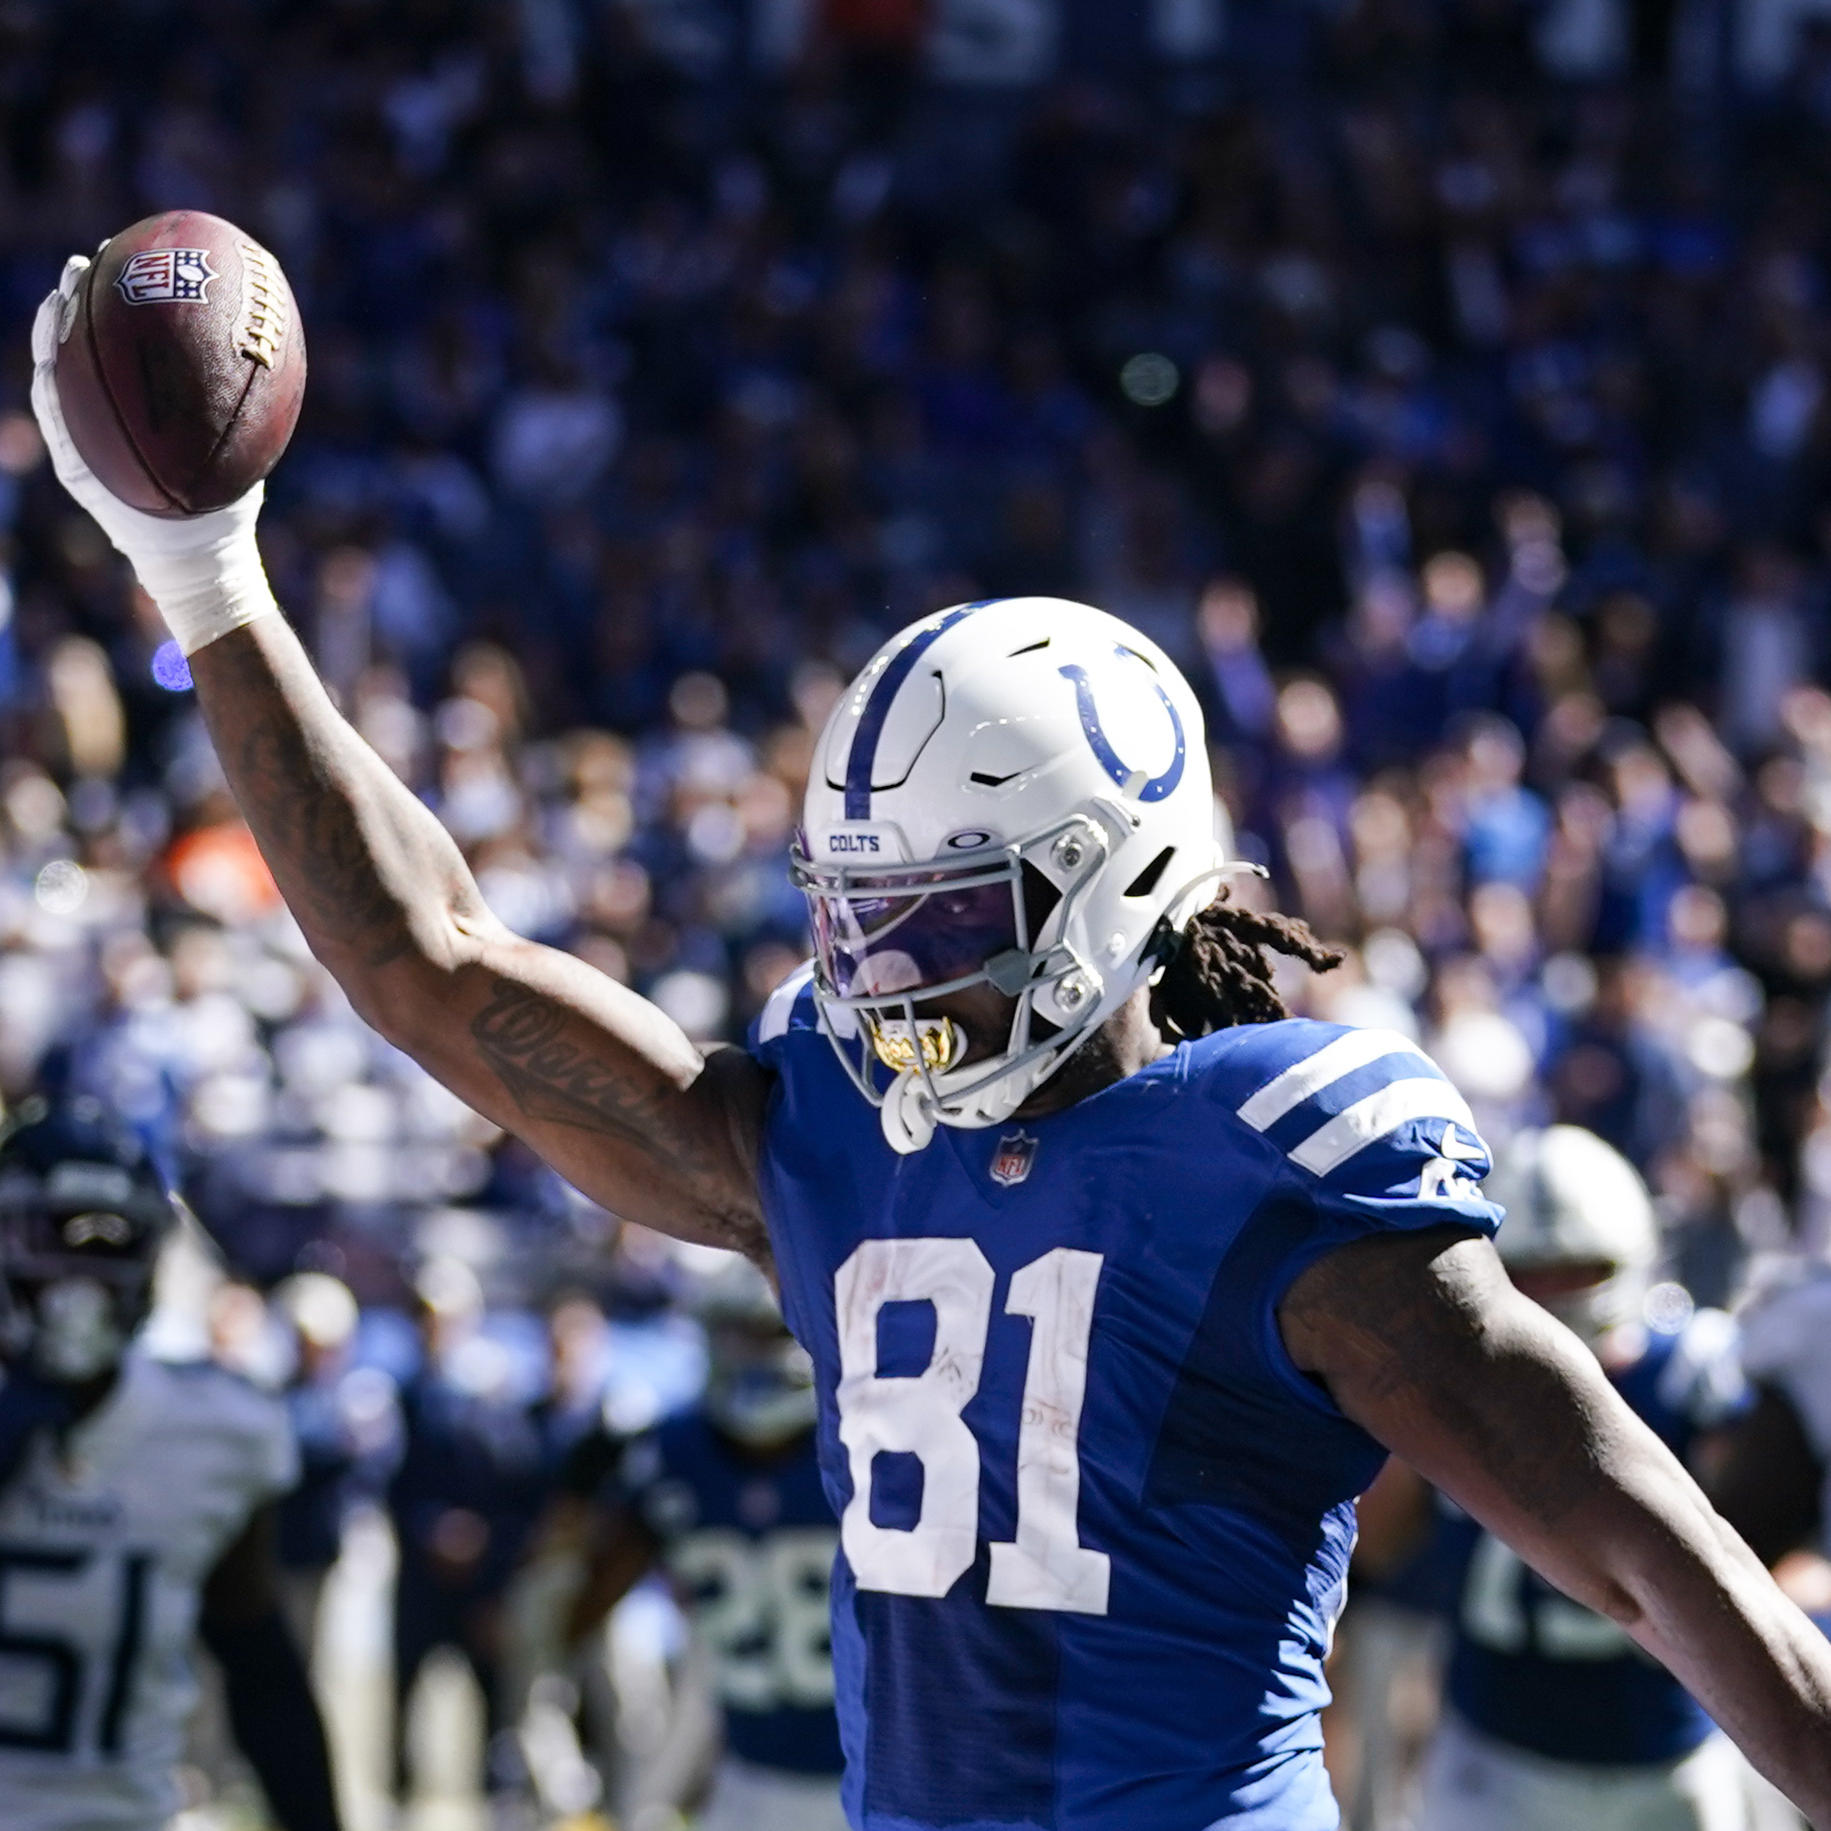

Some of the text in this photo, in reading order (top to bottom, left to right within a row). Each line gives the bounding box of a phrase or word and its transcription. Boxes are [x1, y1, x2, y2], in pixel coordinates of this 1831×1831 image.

[128, 253, 170, 298] NFL
[829, 834, 880, 853] COLTS
[834, 1236, 1111, 1616] 81
